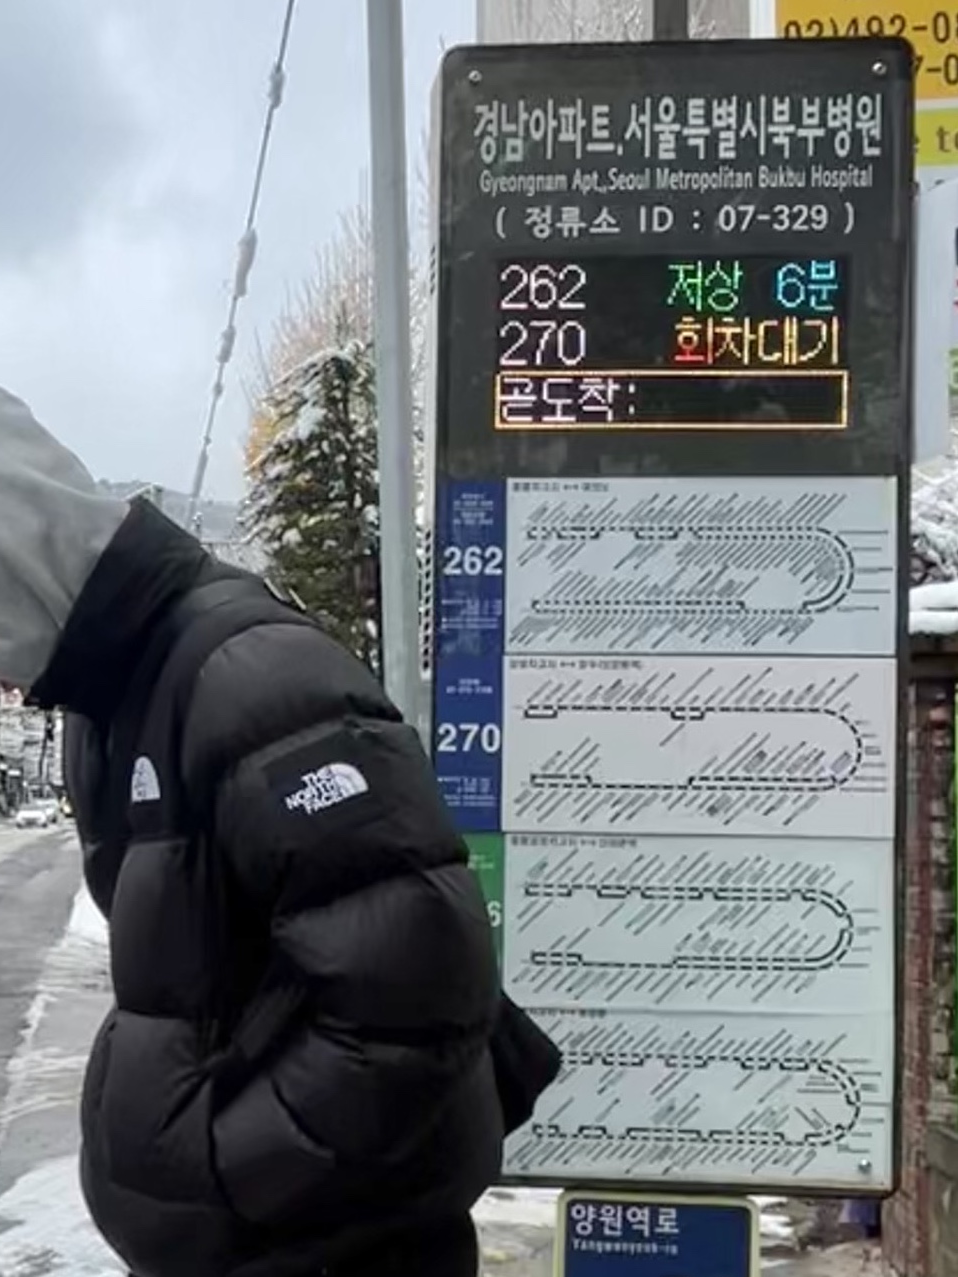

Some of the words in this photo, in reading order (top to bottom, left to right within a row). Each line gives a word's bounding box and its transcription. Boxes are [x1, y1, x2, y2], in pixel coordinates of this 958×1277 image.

[480, 170, 568, 197] Gyeongnam
[656, 165, 753, 194] Metropolitan
[758, 164, 806, 188] Bukbu
[811, 163, 873, 192] Hospital
[524, 205, 621, 239] 정류소
[640, 205, 674, 233] ID
[718, 204, 828, 232] 07-329
[500, 264, 586, 309] 262
[667, 260, 743, 311] 저상
[776, 260, 838, 311] 6분
[499, 320, 586, 366] 270
[674, 316, 839, 366] 회차대기
[443, 545, 503, 575] 262
[437, 722, 501, 753] 270
[571, 1204, 680, 1237] 양원역로
